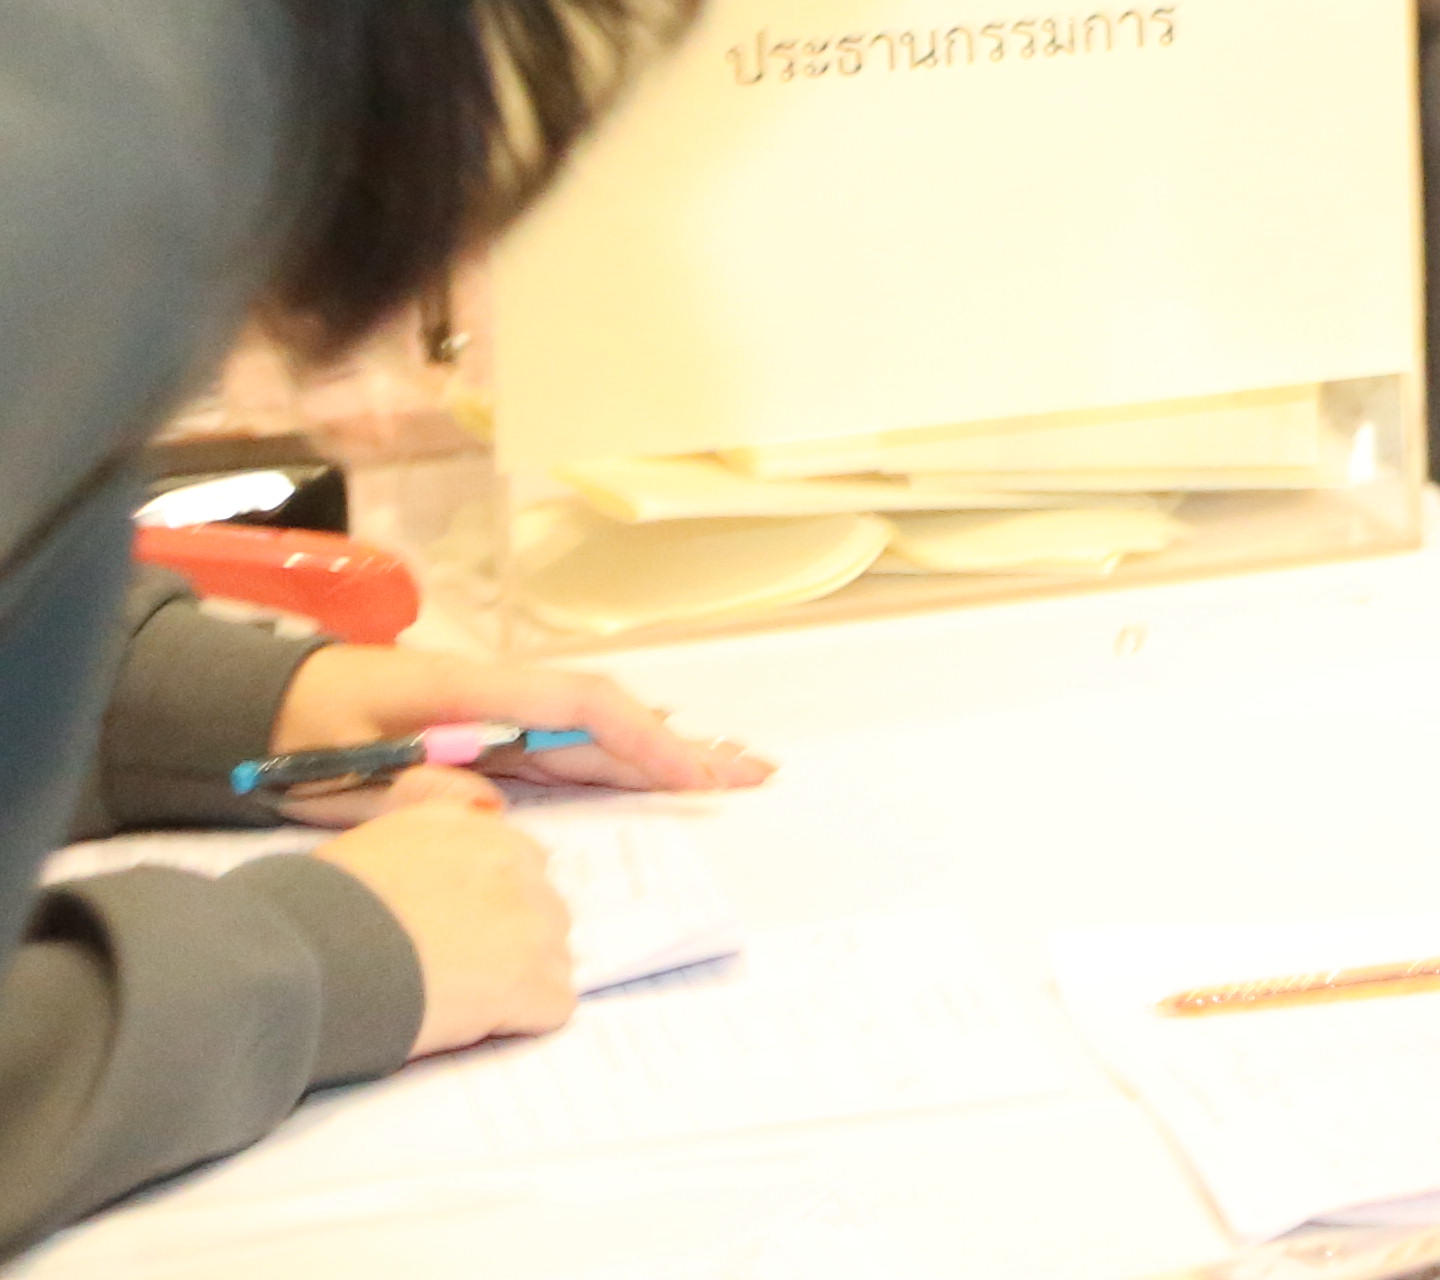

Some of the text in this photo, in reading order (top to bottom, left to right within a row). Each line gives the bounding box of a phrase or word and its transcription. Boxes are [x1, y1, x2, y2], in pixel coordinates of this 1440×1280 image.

[727, 4, 1176, 86] ประธานกรรมการ
